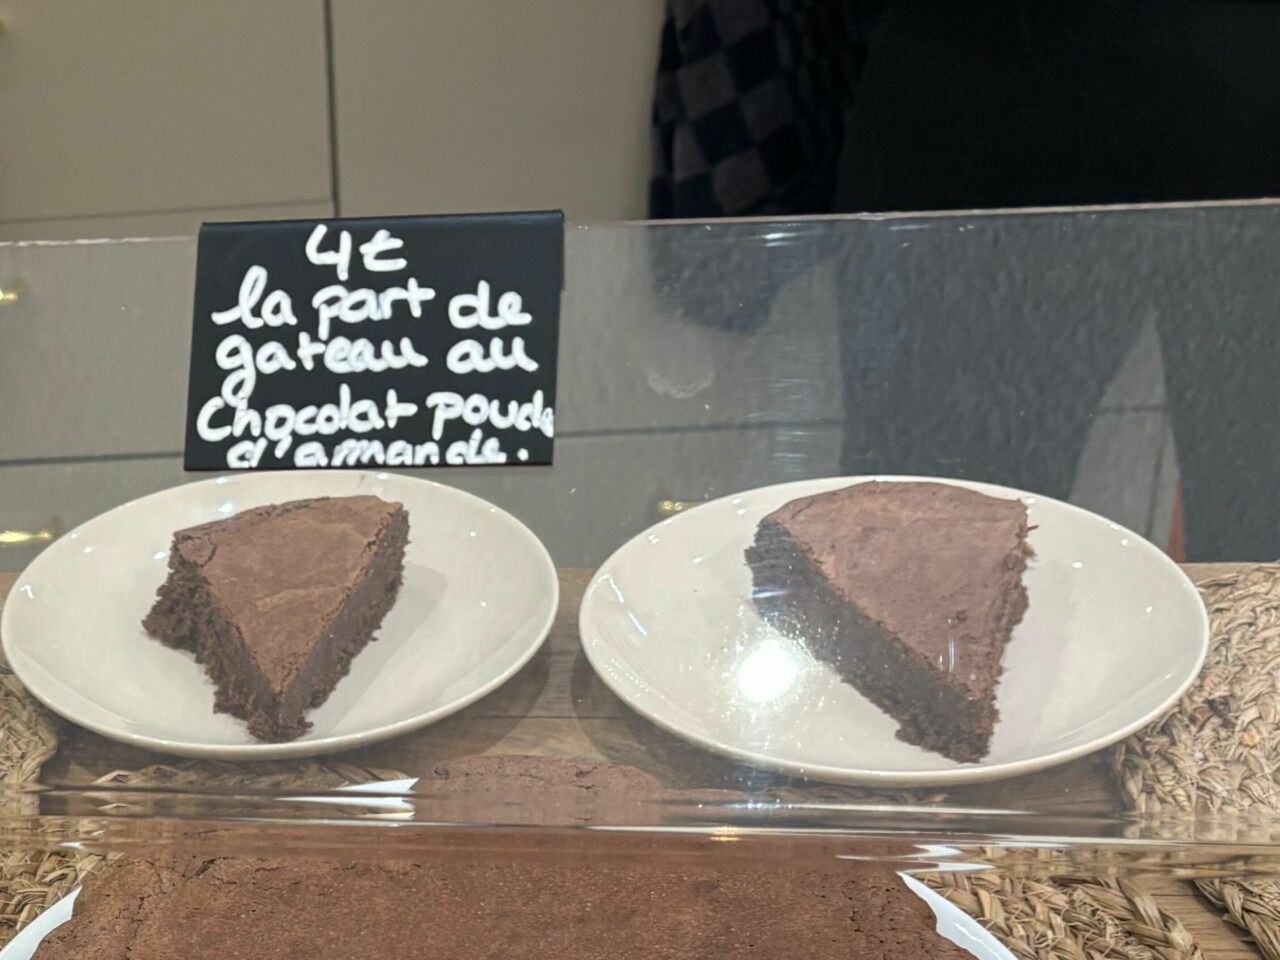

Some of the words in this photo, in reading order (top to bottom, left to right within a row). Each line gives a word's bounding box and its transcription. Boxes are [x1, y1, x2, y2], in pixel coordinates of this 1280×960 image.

[211, 265, 297, 329] la
[312, 277, 435, 340] part
[448, 280, 532, 330] de
[446, 337, 539, 374] au
